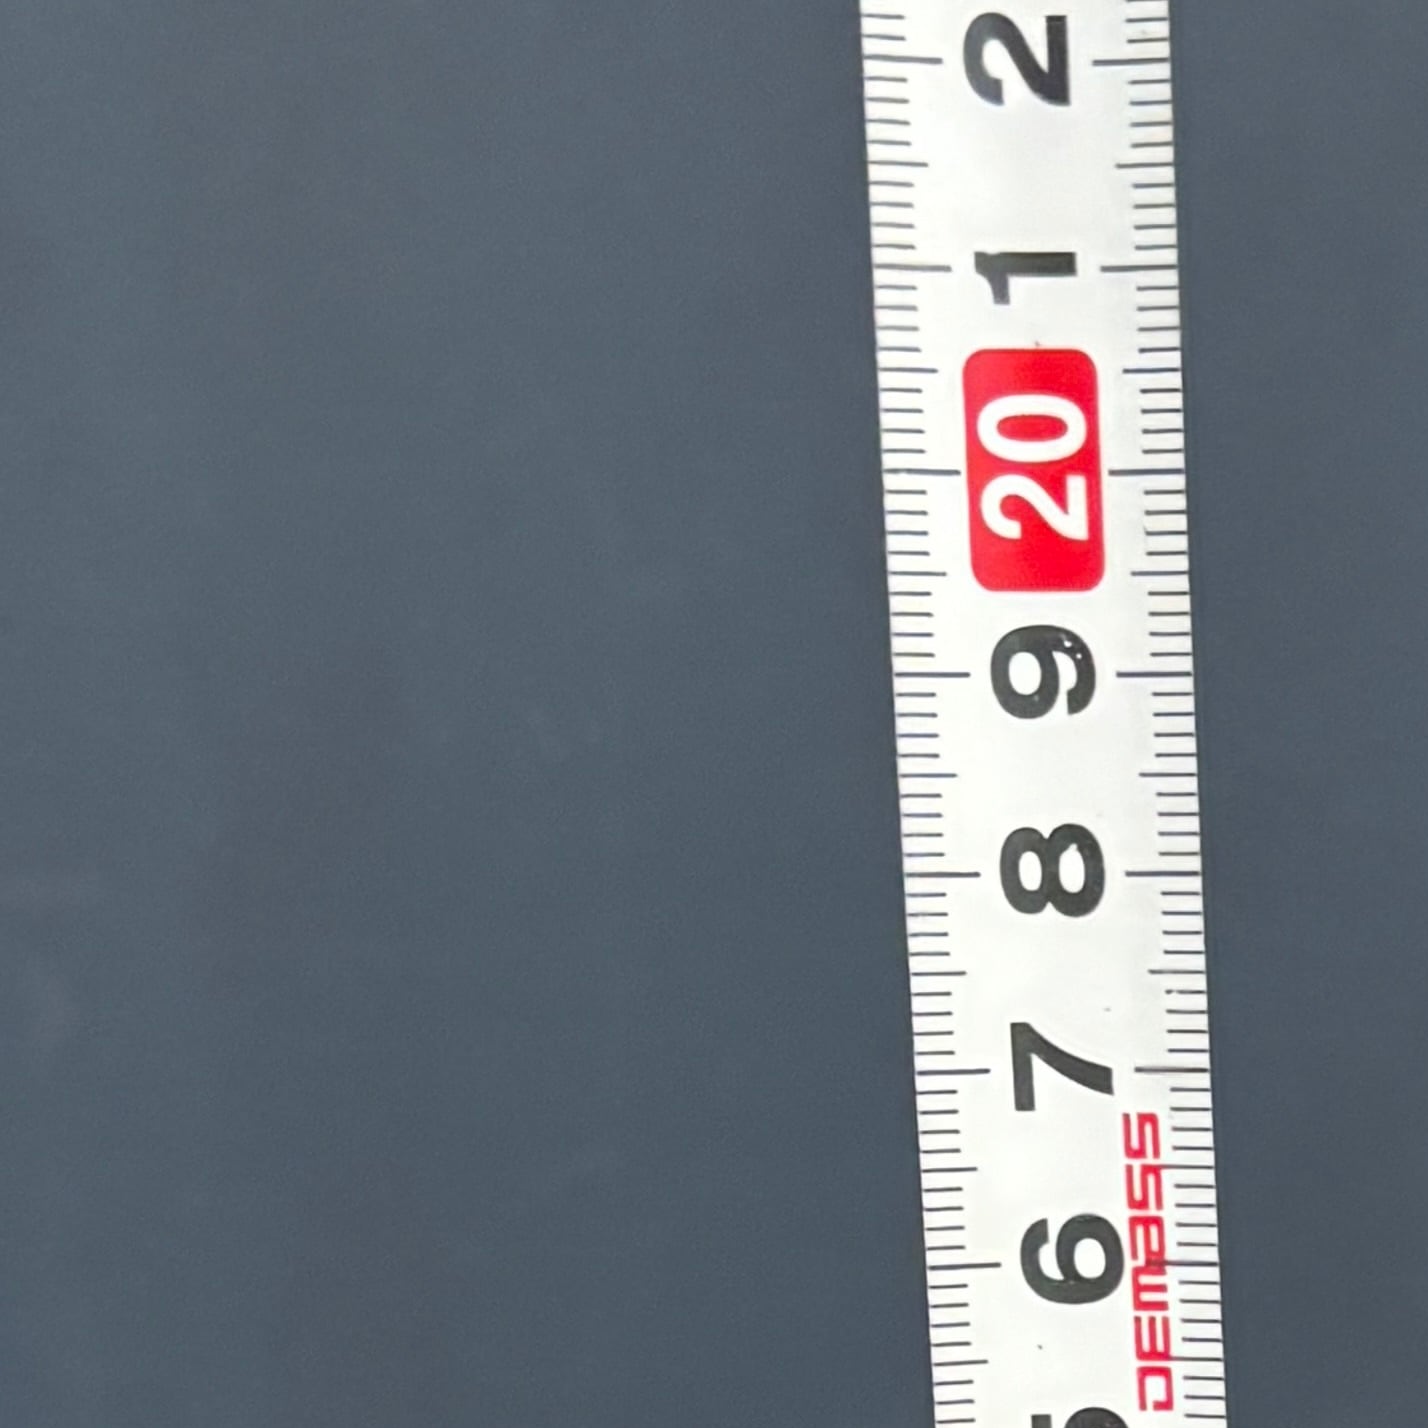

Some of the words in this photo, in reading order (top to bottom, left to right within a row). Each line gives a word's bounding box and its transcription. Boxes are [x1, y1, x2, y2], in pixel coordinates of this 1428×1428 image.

[963, 11, 1071, 106] 2
[973, 251, 1077, 305] 1
[977, 394, 1089, 541] 20
[990, 624, 1096, 719] 9
[1000, 823, 1105, 918] 8
[1010, 1022, 1115, 1112] 7
[1020, 1213, 1125, 1305] 6
